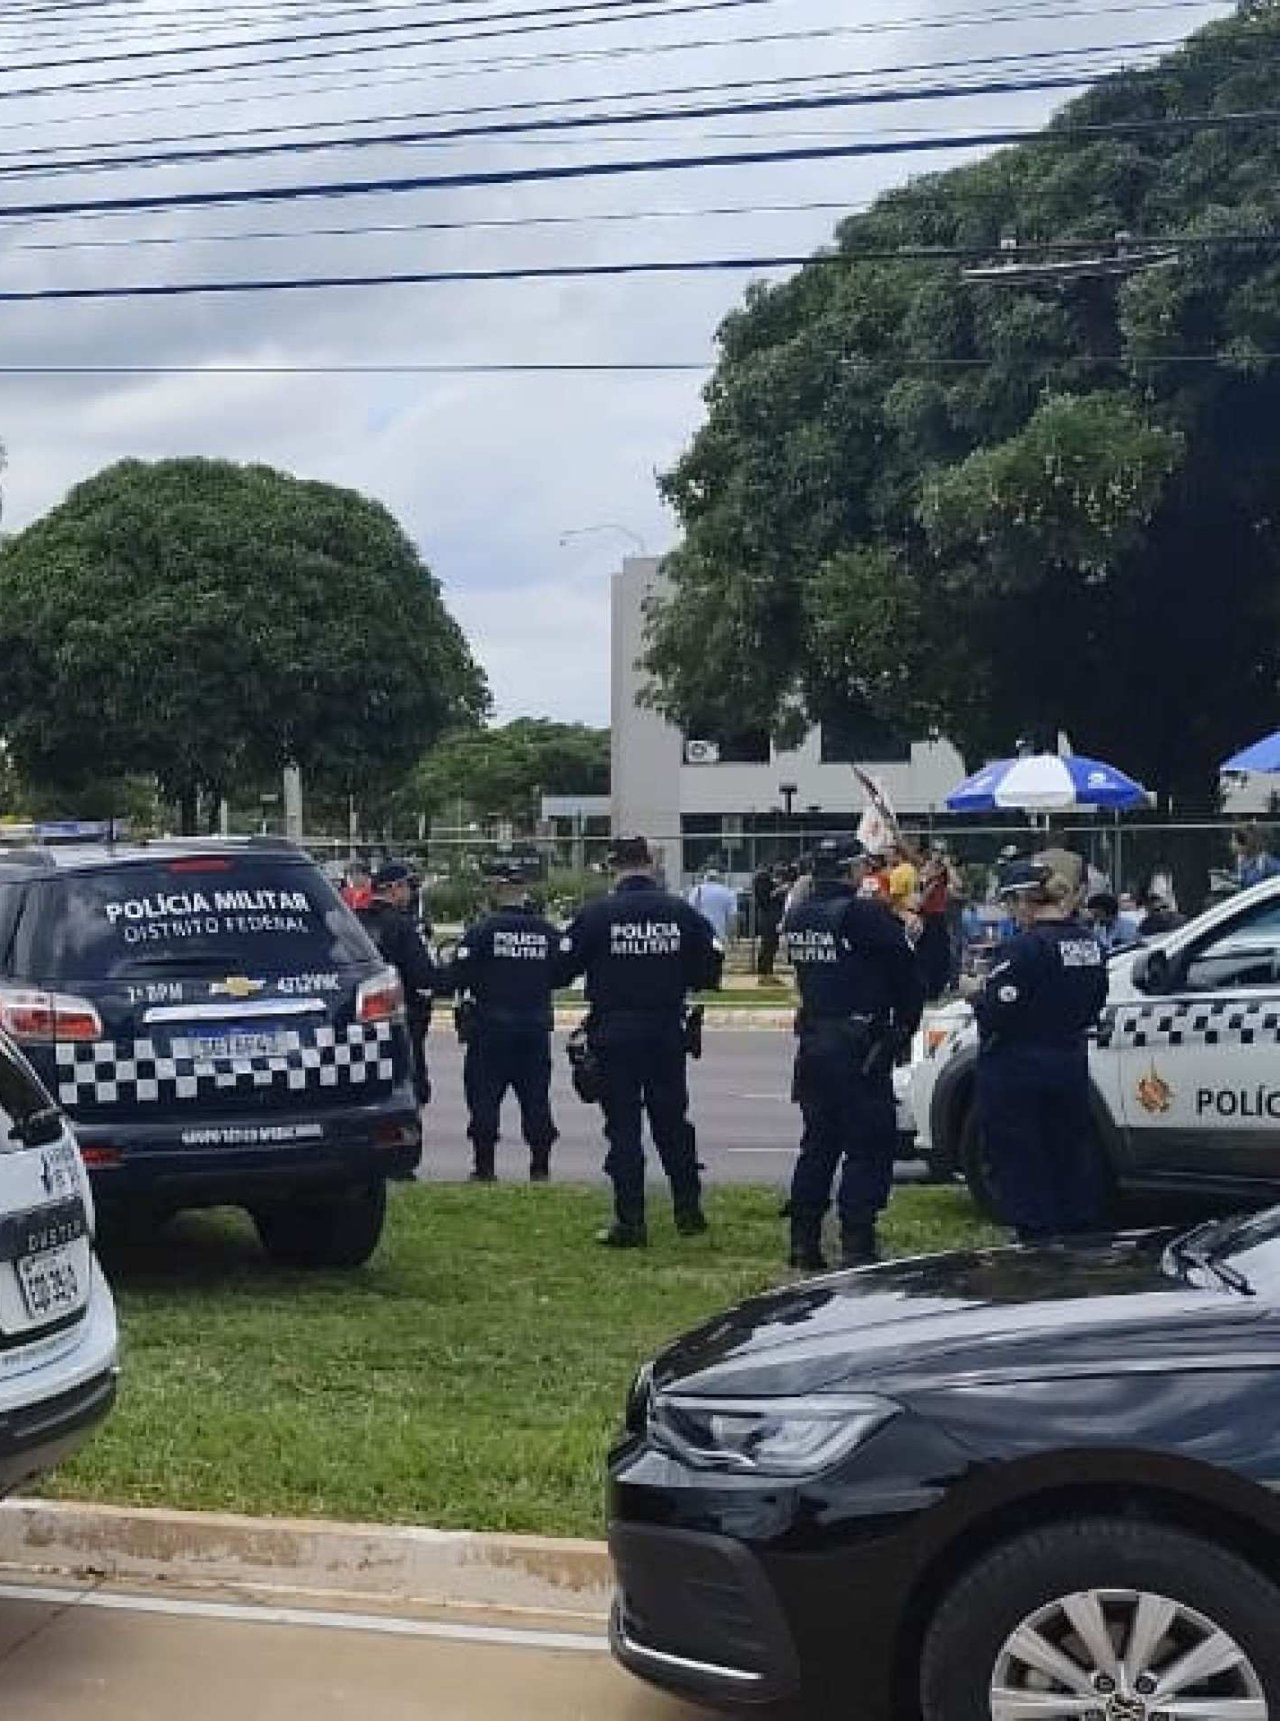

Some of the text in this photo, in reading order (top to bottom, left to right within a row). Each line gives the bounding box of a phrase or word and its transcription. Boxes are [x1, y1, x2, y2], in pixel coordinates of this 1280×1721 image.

[106, 891, 311, 924] POLÍCIA MILITAR
[125, 915, 309, 942] DISTRITO FEDERAL
[610, 919, 680, 939] POLÍCIA
[610, 939, 680, 955] MILITAR
